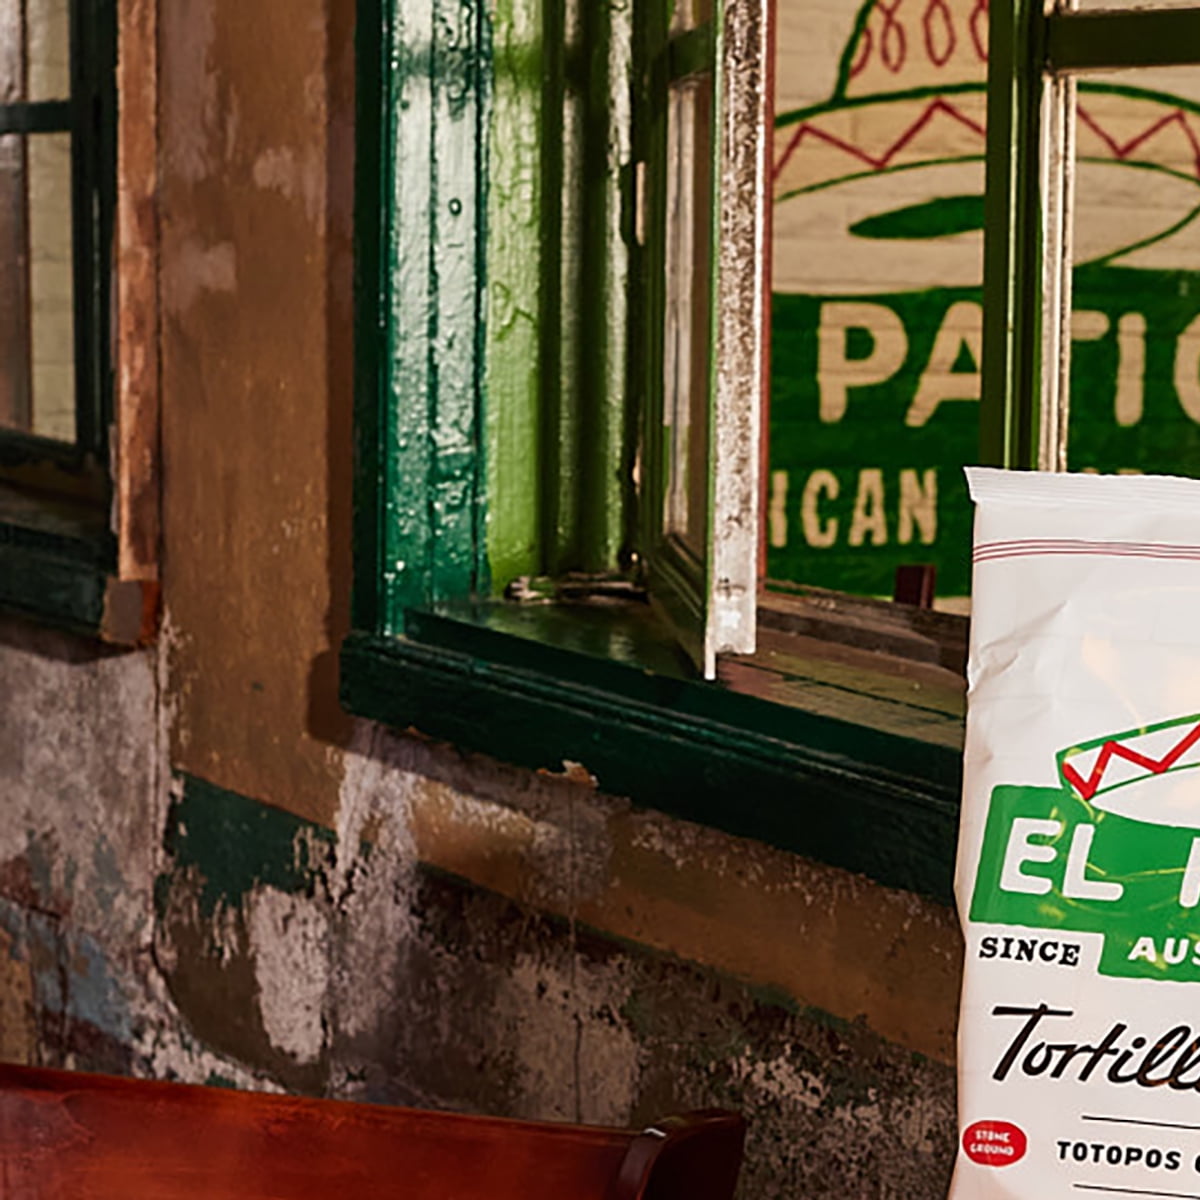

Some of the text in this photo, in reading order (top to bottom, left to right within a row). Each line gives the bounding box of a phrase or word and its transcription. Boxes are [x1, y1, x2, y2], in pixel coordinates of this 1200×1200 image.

[1000, 817, 1124, 904] EL
[978, 936, 1081, 968] SINCE
[1057, 1140, 1182, 1171] TOTOPOS
